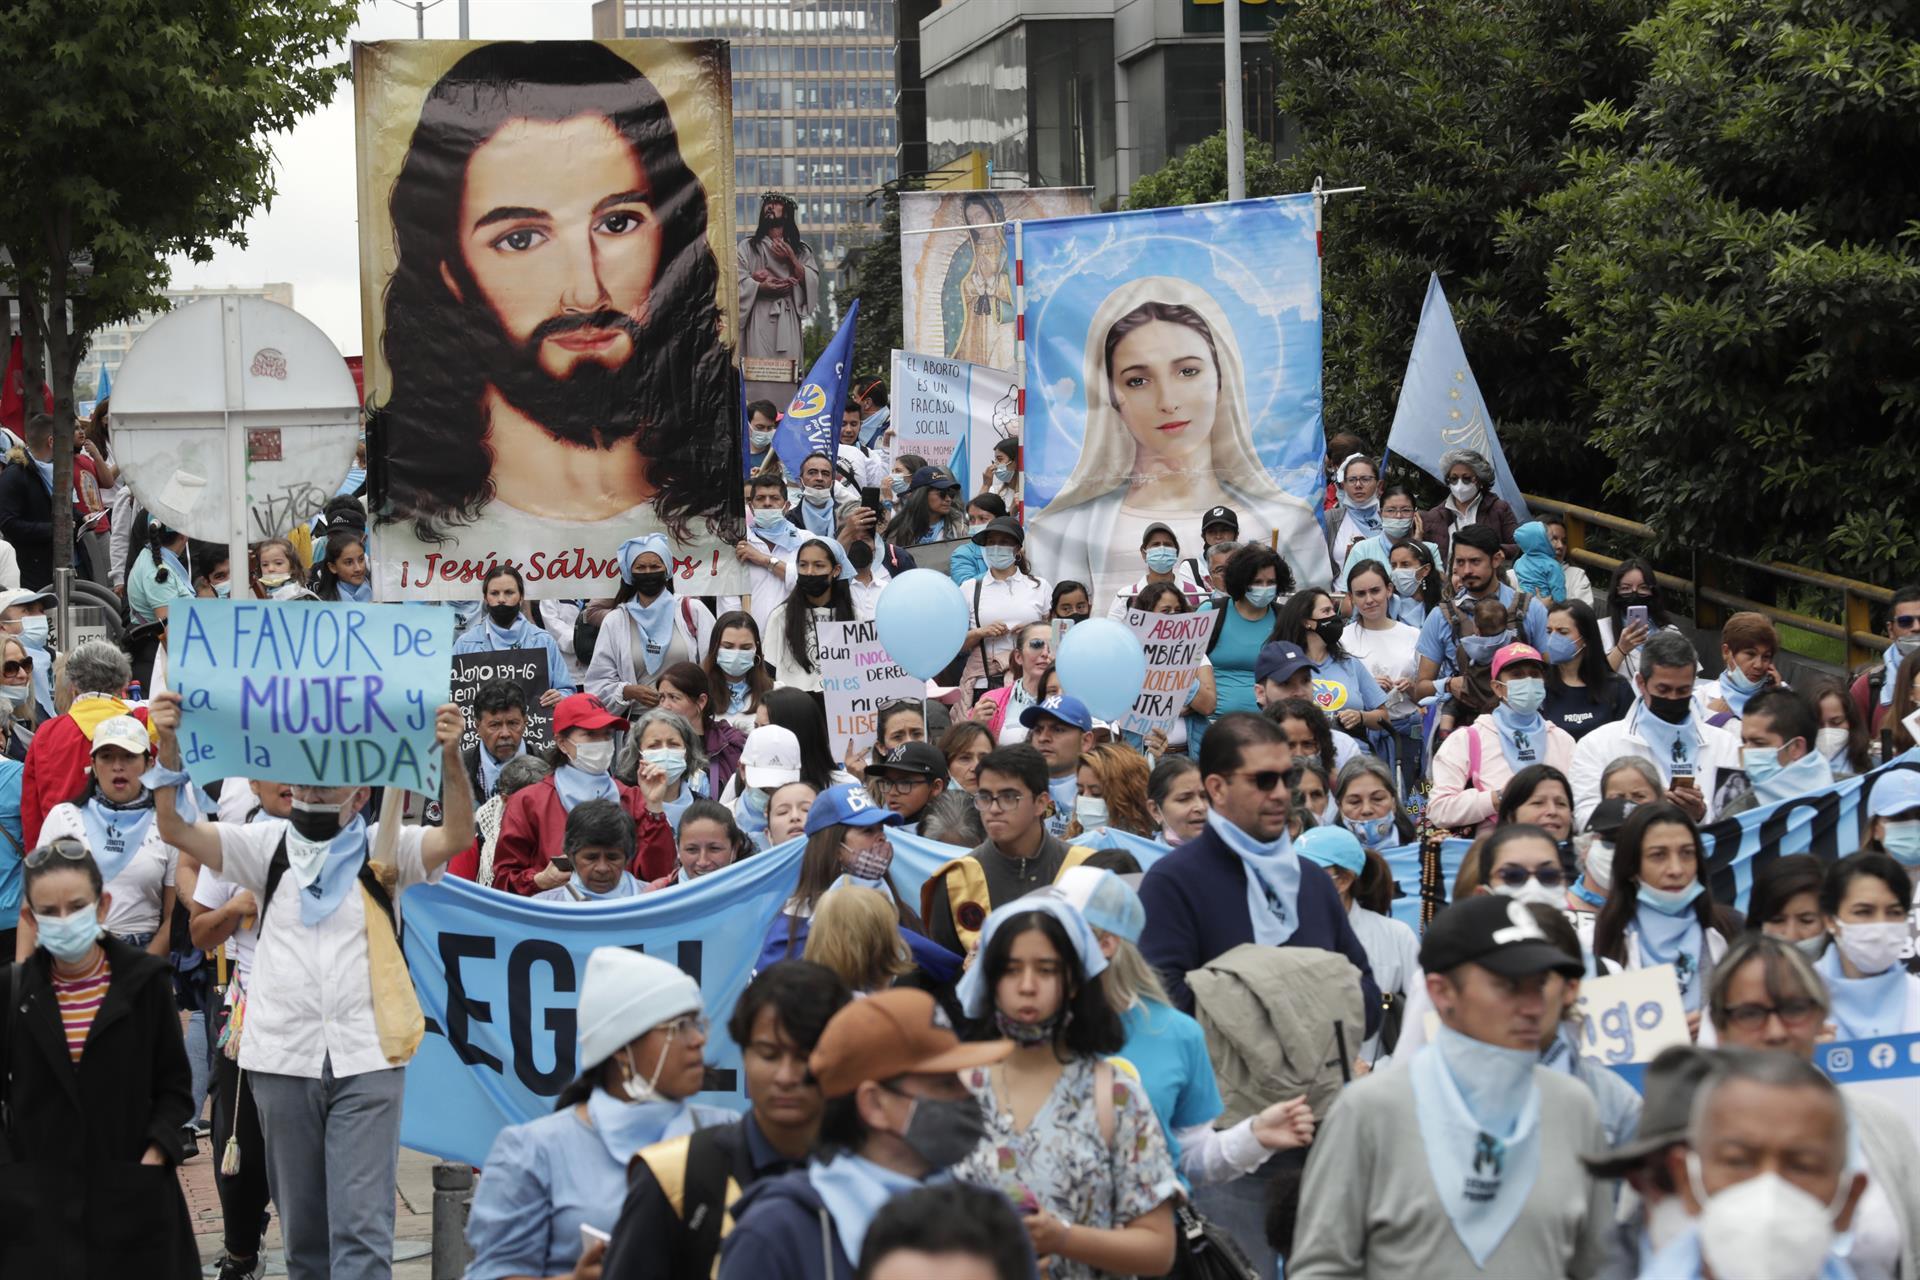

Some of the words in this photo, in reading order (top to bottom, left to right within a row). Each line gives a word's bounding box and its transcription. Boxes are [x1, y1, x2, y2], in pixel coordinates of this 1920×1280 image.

[907, 358, 917, 372] EL
[923, 361, 960, 378] ABORTO
[918, 378, 928, 392] ES
[934, 383, 948, 394] UN
[911, 398, 955, 414] FRACASO
[915, 420, 950, 435] SOCIAL
[180, 606, 217, 668] A
[233, 606, 382, 671] FAVOR
[843, 620, 878, 645] MAT
[1148, 616, 1210, 640] ABORTO
[1143, 640, 1197, 665] MBIÉN
[450, 658, 493, 682] almo
[497, 663, 536, 680] 139-16
[241, 675, 398, 734] MUJER
[1132, 694, 1174, 717] NTRA
[837, 713, 878, 735] LIBE
[185, 732, 216, 765] de
[244, 736, 272, 768] la
[300, 737, 424, 789] VIDA
[1578, 996, 1663, 1064] igo
